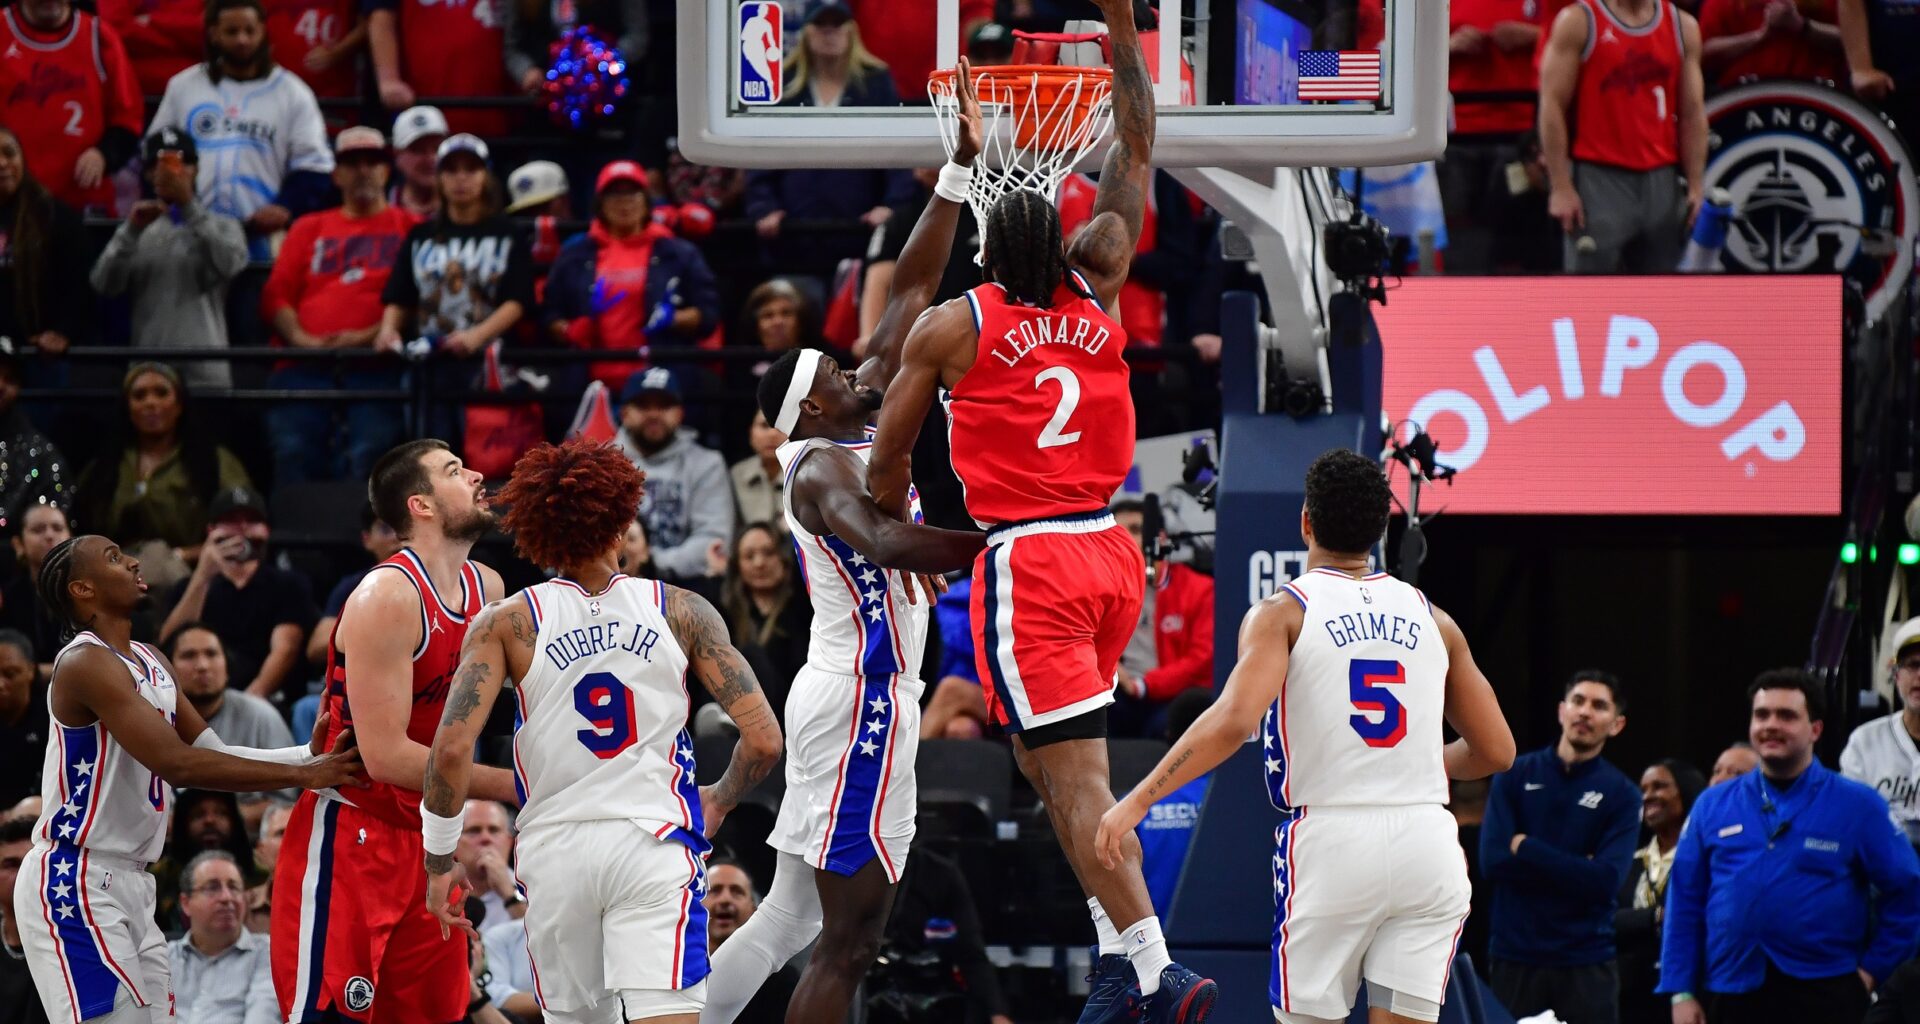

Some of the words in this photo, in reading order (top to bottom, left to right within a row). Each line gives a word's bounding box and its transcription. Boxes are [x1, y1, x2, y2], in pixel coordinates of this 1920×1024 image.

[744, 80, 766, 98] NBA
[1652, 84, 1668, 121] 1
[63, 99, 84, 136] 2
[1745, 106, 1886, 193] ANGELES
[991, 315, 1110, 368] LEONARD
[1035, 365, 1082, 449] 2
[1405, 314, 1806, 474] OLIPOP
[545, 621, 619, 671] OUBRE
[621, 623, 659, 663] JR.
[1325, 612, 1421, 650] GRIMES
[573, 671, 638, 760] 9
[1349, 658, 1407, 749] 5
